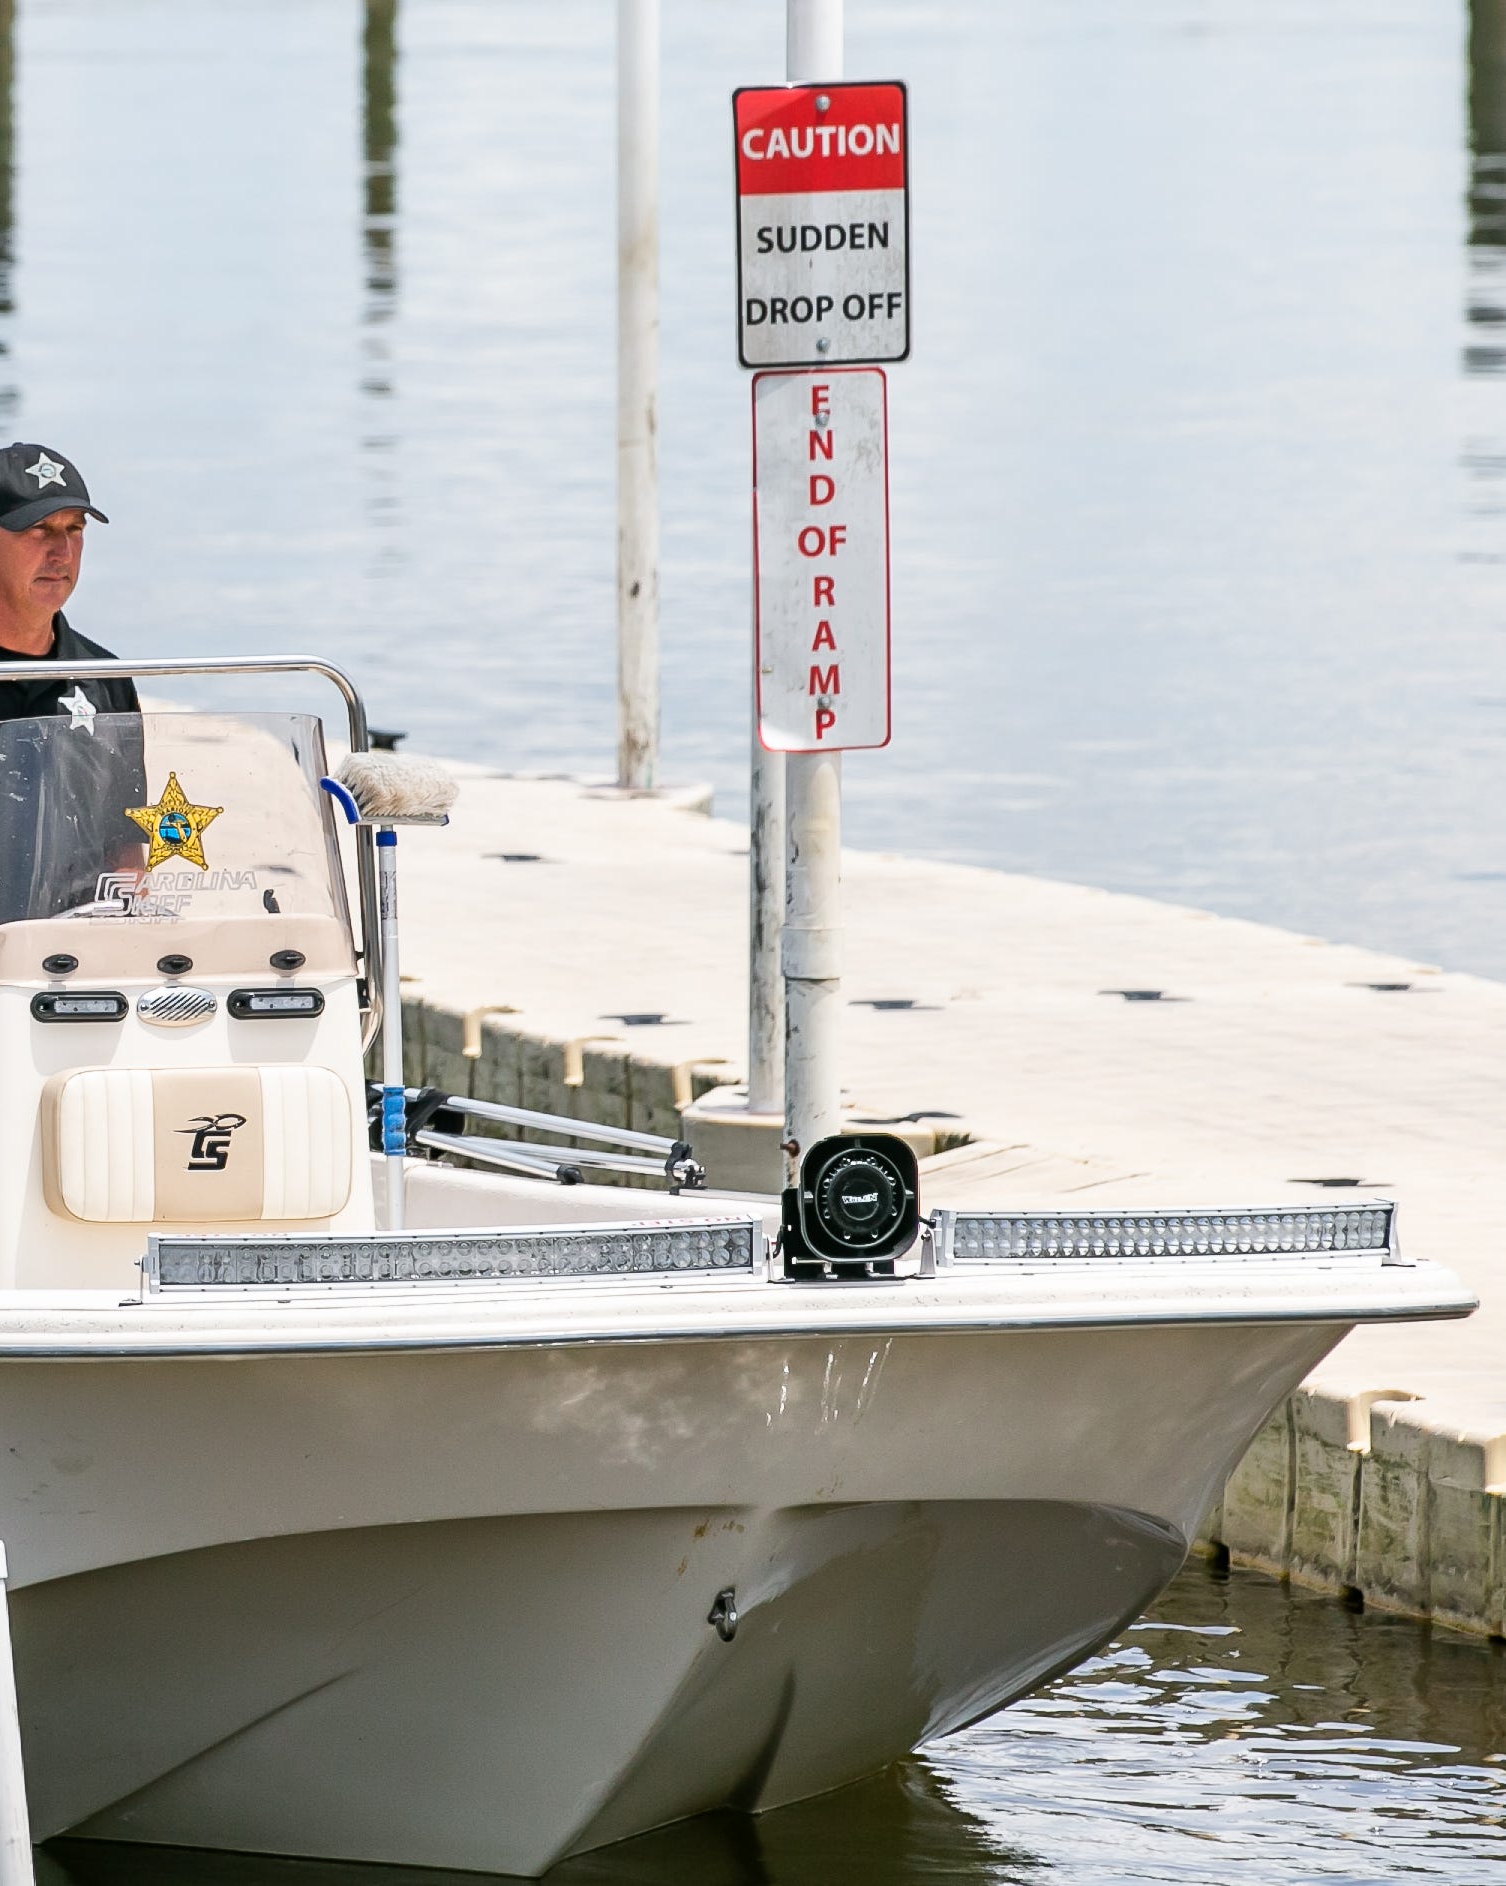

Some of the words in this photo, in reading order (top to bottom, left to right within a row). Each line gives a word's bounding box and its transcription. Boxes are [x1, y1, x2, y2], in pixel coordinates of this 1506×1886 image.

[742, 123, 900, 160] CAUTION
[756, 222, 889, 253] SUDDEN
[746, 295, 834, 325] DROP
[842, 292, 902, 321] OFF
[808, 385, 835, 505] END
[797, 525, 846, 557] OF
[809, 576, 840, 739] RAMP
